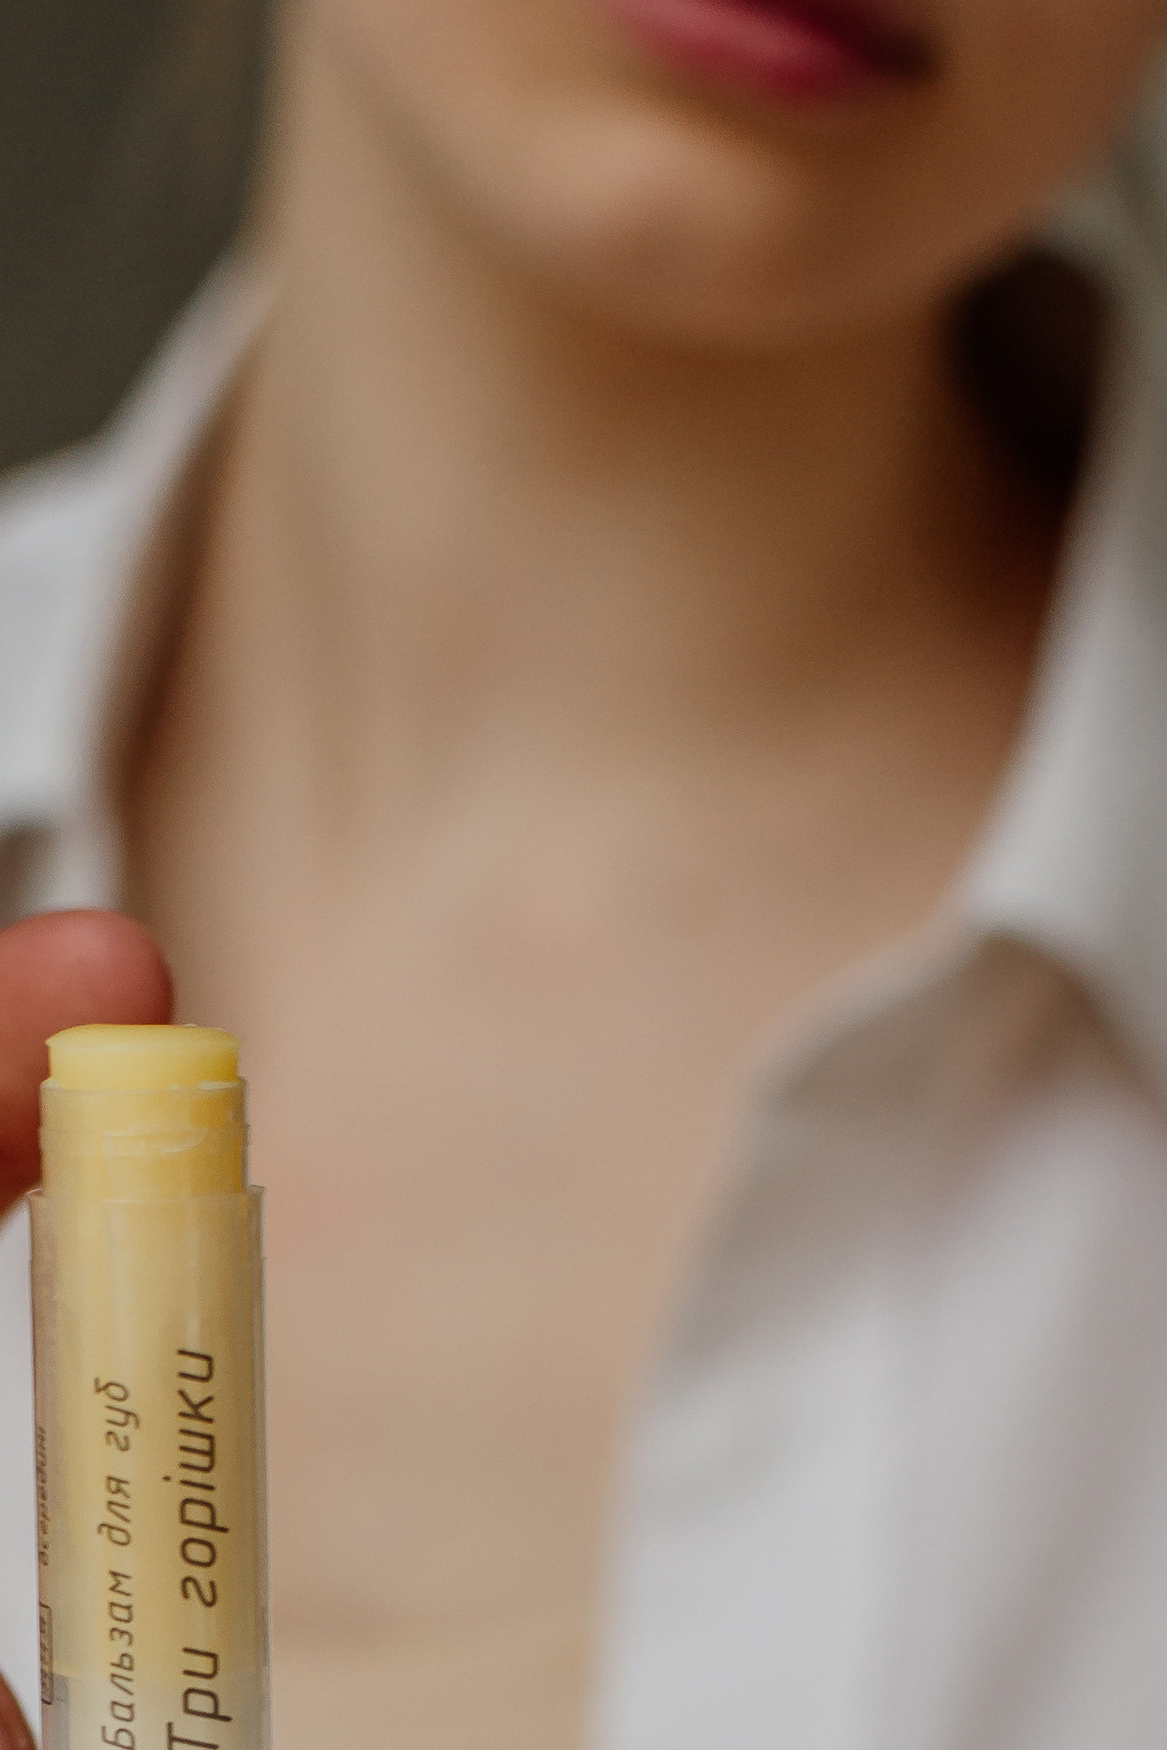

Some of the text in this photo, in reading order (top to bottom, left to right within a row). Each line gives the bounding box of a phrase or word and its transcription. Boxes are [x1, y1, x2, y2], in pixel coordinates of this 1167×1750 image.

[94, 1377, 140, 1750] Бальзам для губ
[163, 1349, 229, 1608] горішки
